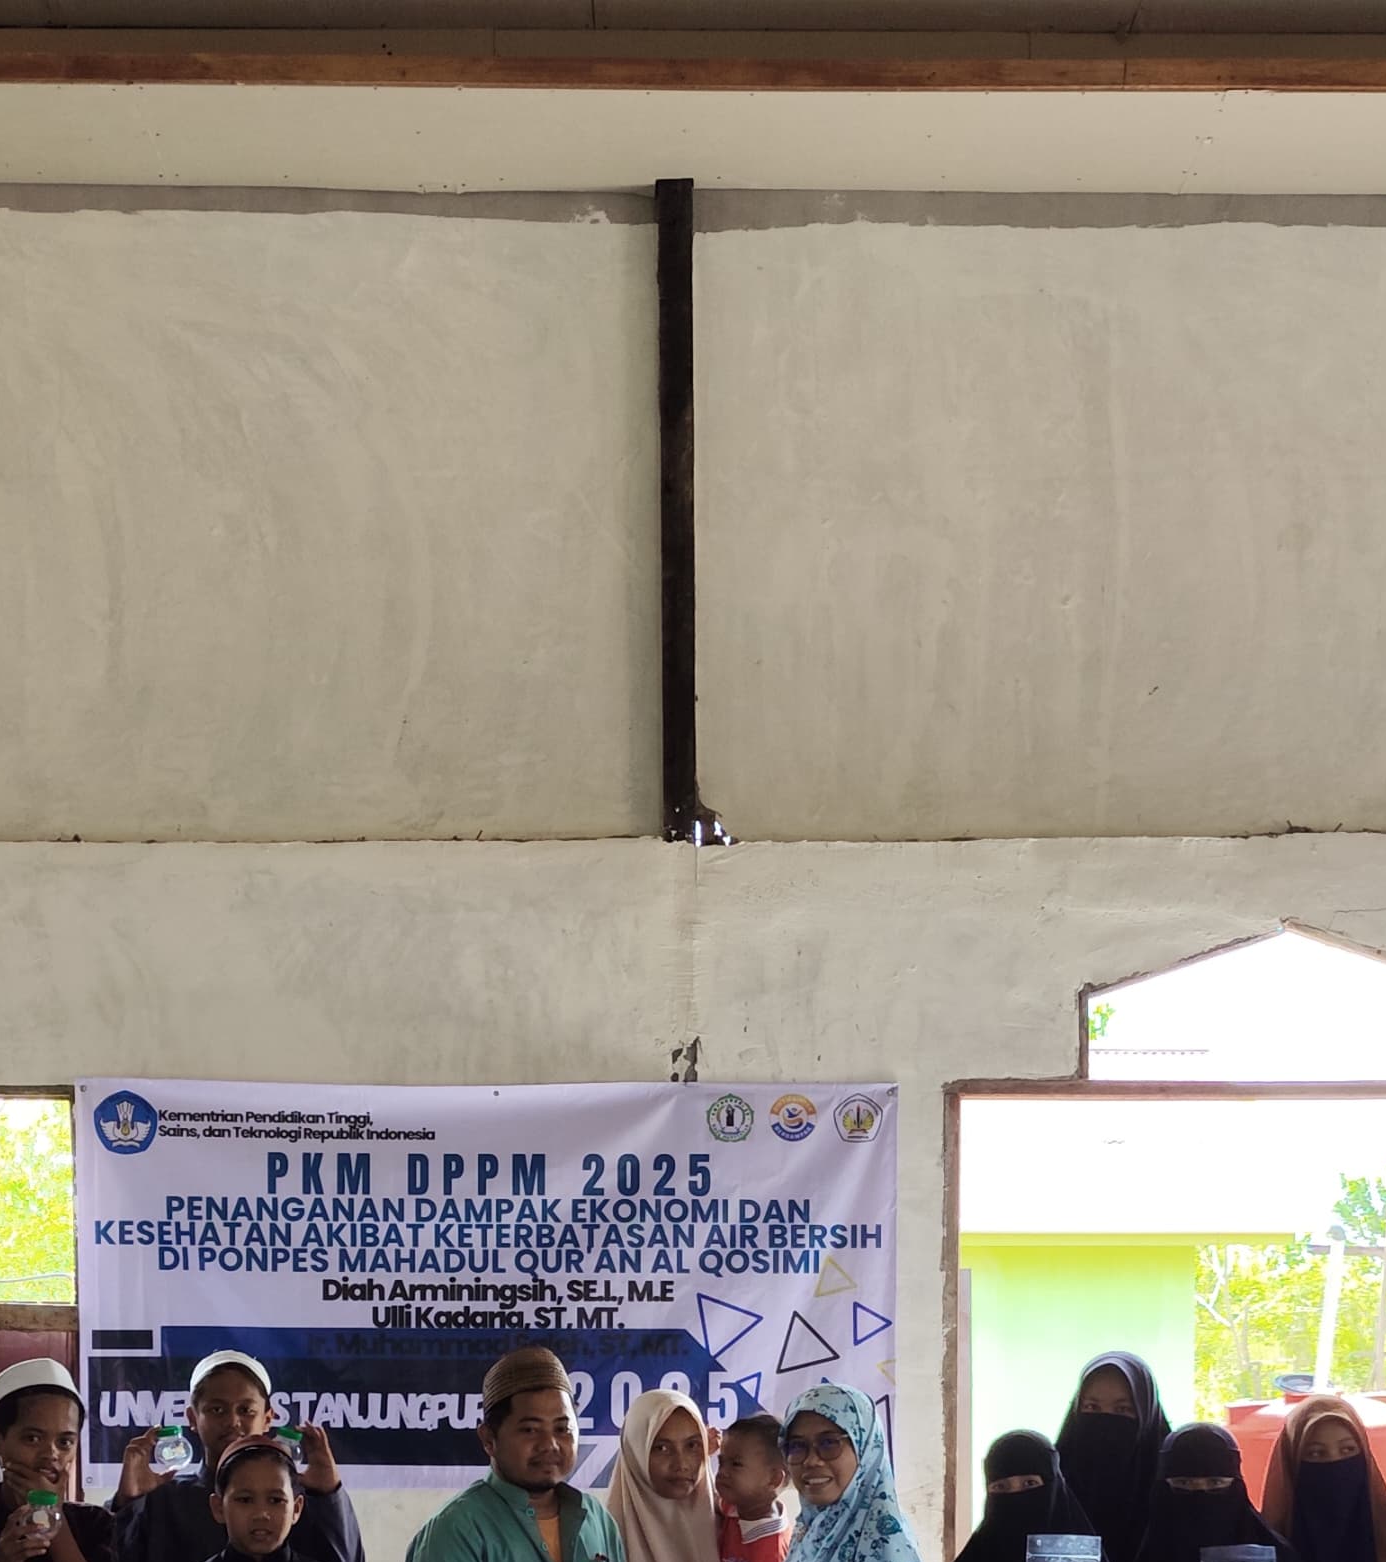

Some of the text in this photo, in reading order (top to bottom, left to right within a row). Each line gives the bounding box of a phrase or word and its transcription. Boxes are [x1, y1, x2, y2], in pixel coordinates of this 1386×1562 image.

[158, 1109, 374, 1129] Kementrian Pendidikan Tinggi,
[158, 1124, 436, 1143] Sains, dan Teknologi Republik Indonesia
[267, 1151, 711, 1197] PKM DPPM 2025
[165, 1195, 811, 1224] PENANGANAN DAMPAK EKONOMI DAN
[94, 1220, 882, 1249] KESEHATAN AKIBAT KETERBATASAN AIR BERSIH
[158, 1246, 821, 1278] DI PONPES MAHADUL QUR'AN AL QOSIMI
[322, 1277, 385, 1301] Diah
[388, 1276, 563, 1309] Arminingsih,
[627, 1280, 675, 1302] M.E
[372, 1304, 412, 1328] Ulli
[534, 1307, 574, 1329] ST,
[576, 1307, 626, 1329] MT.
[567, 1371, 739, 1430] 205
